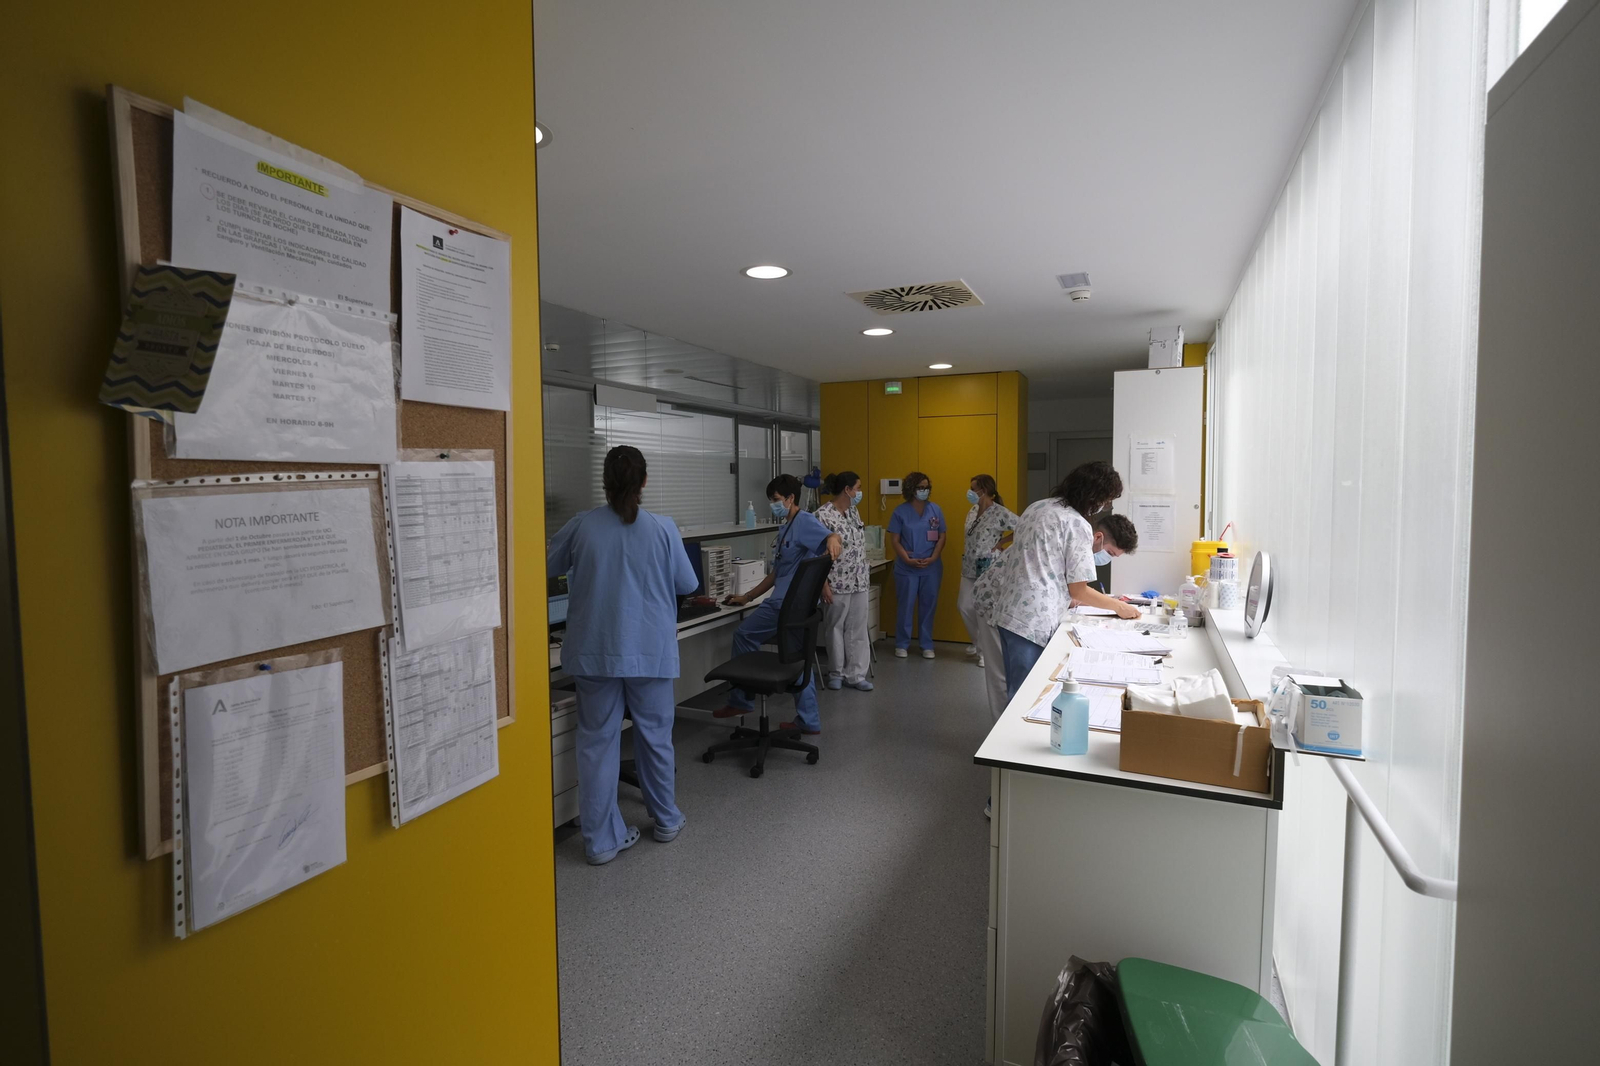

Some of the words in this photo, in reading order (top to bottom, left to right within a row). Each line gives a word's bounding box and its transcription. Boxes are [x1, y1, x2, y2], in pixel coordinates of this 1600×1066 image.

[257, 162, 325, 195] IMPORTANTE
[202, 169, 242, 188] RECUERDO
[250, 186, 269, 197] TODO
[280, 197, 314, 213] PERSONAL
[335, 215, 357, 227] UNIDAD
[358, 223, 372, 232] QUE:
[217, 198, 231, 207] LOS
[251, 210, 261, 218] (SE
[293, 223, 306, 232] QUE
[217, 204, 231, 213] LOS
[234, 210, 261, 223] TURNOS
[273, 223, 298, 236] NOCHE)
[228, 194, 246, 205] DEBE
[249, 202, 278, 215] REVISAR
[289, 215, 311, 226] CARRO
[322, 226, 347, 238] PARADA
[348, 234, 368, 244] TODAS
[217, 234, 244, 245] canguro
[219, 220, 271, 240] CUMPLIMENTAR
[289, 239, 331, 258] INDICADORES
[342, 256, 366, 268] CALIDAD
[229, 229, 242, 238] LAS
[298, 250, 326, 262] centrales,
[328, 258, 352, 269] cuidados
[345, 296, 374, 307] Supervisor
[253, 327, 291, 339] REVISIÓN
[294, 334, 339, 347] PROTOCOLO
[342, 342, 365, 351] DUELO
[247, 339, 271, 348] (CAJA
[287, 345, 335, 358] RECUERDOS)
[267, 355, 311, 366] MIERCOLES
[273, 368, 307, 378] VIERNES
[273, 381, 305, 389] MARTES
[273, 393, 305, 402] MARTES
[280, 418, 316, 427] HORARIO
[215, 517, 246, 529] NOTA
[250, 512, 320, 526] IMPORTANTE
[267, 537, 306, 546] ENFERMERO/A
[284, 542, 313, 551] sombreado
[266, 570, 284, 578] trabajo
[1310, 699, 1327, 710] 50
